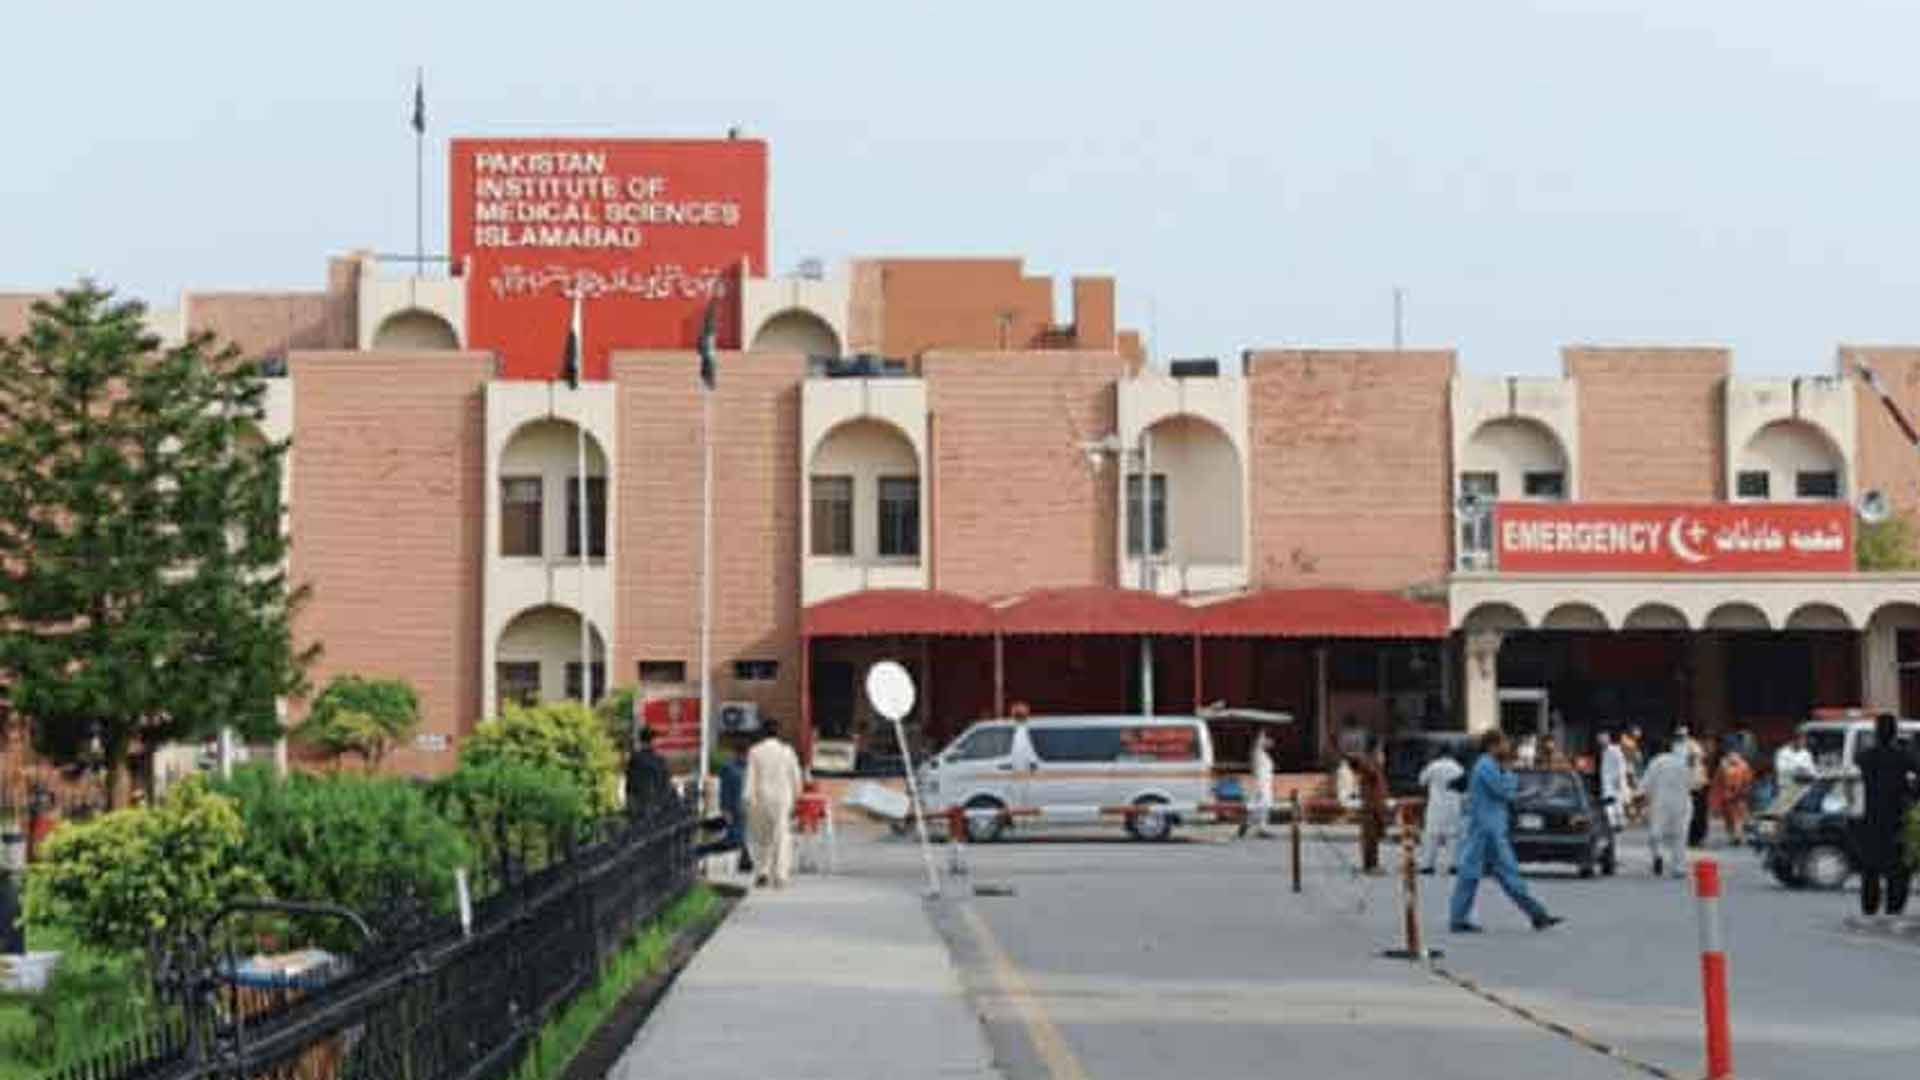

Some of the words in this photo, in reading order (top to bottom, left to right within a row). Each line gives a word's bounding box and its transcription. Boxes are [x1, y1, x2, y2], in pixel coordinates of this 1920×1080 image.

[475, 152, 606, 174] PAKISTAN
[475, 177, 618, 199] INSTITUTE
[627, 177, 666, 199] OF
[475, 202, 598, 223] MEDICAL
[605, 202, 740, 225] SCIENCES
[475, 226, 642, 247] ISLAMABAD
[1502, 520, 1663, 554] EMERGENCY
